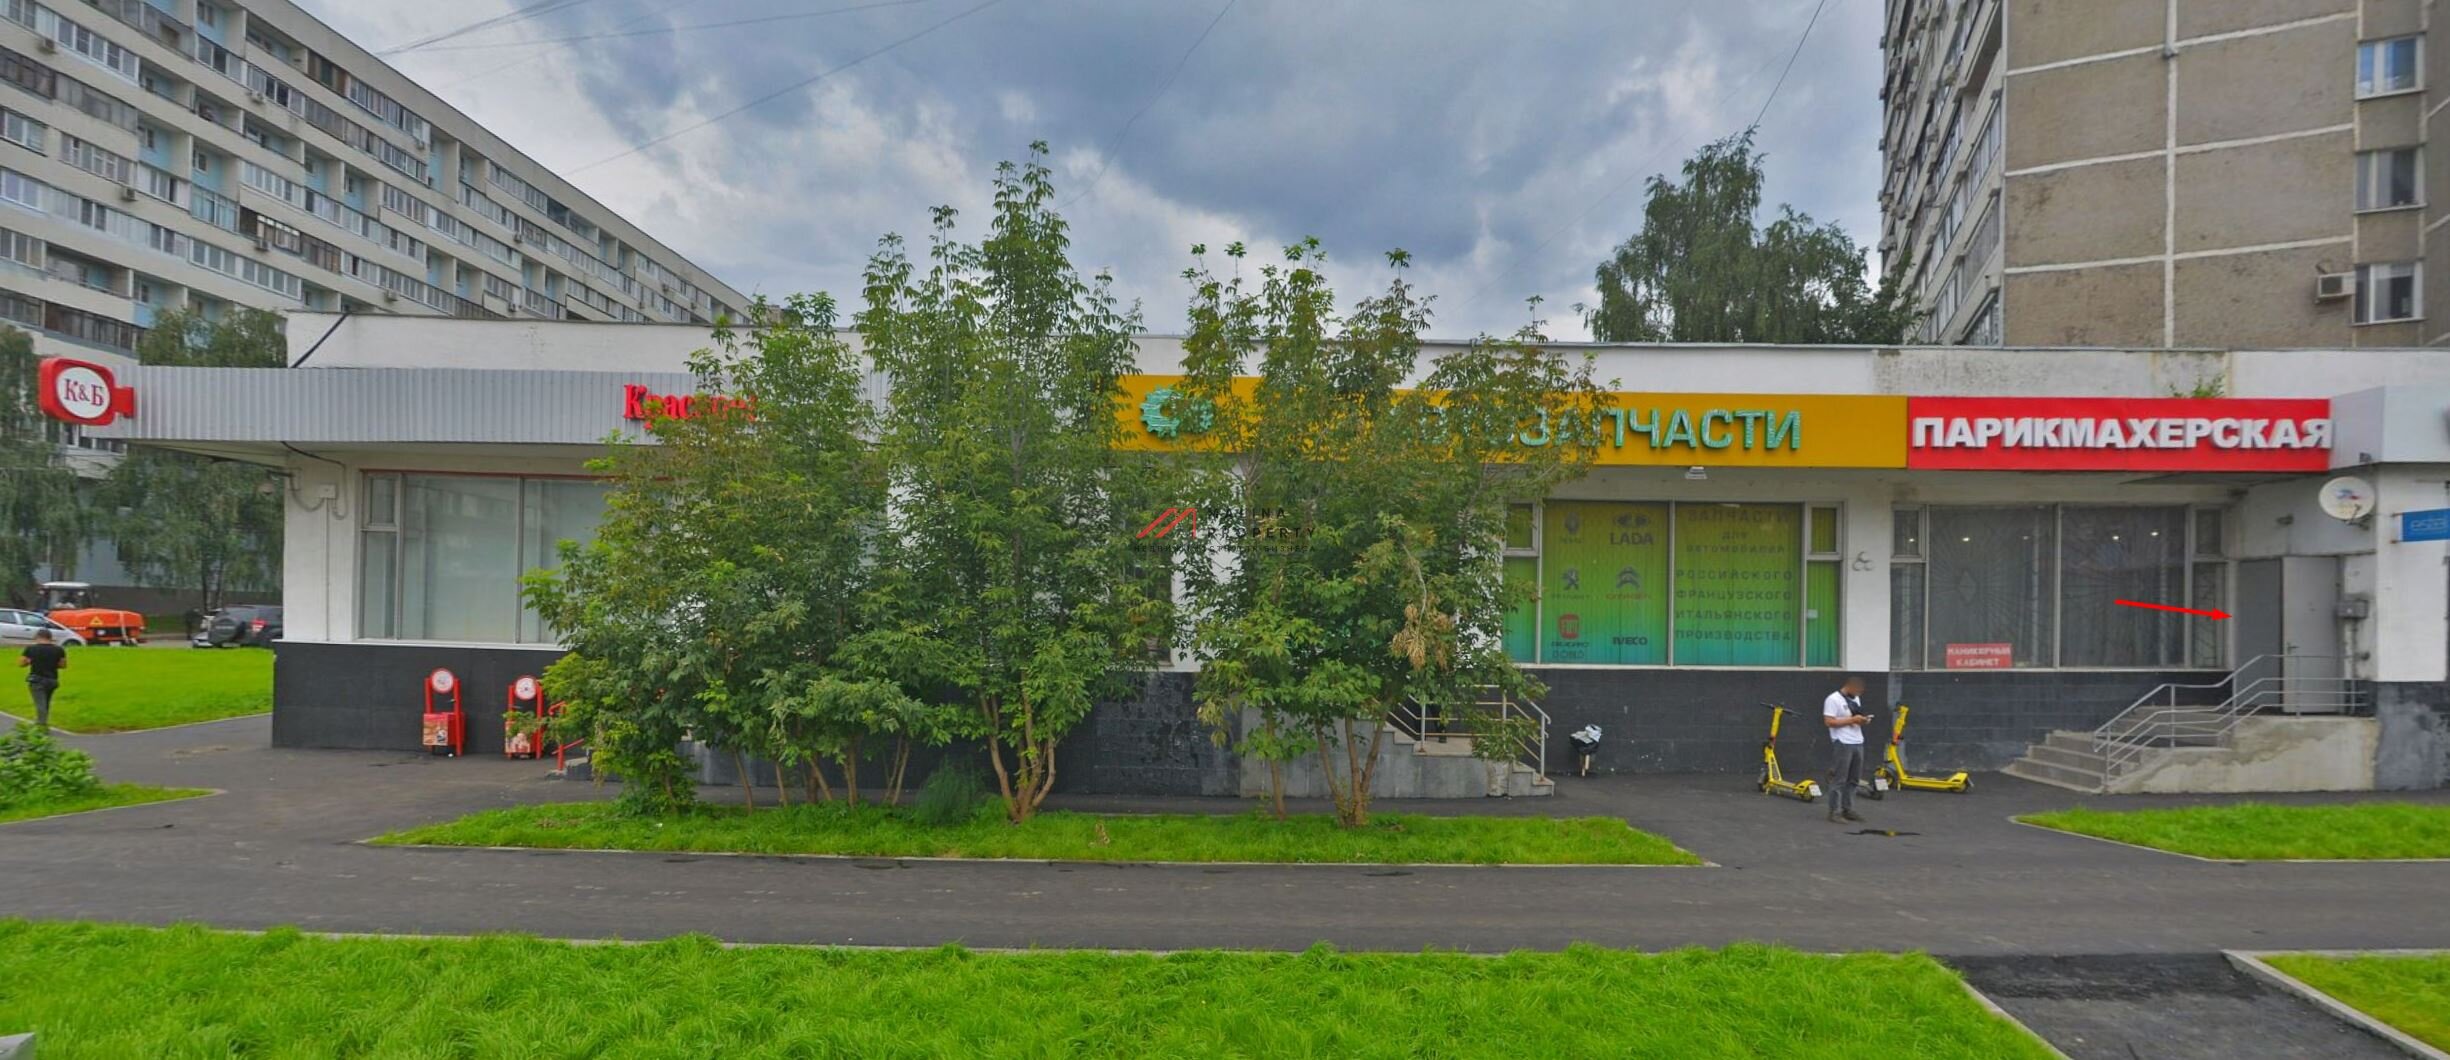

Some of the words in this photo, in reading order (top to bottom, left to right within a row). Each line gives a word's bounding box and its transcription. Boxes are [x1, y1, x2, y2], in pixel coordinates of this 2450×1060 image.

[63, 378, 104, 406] К&Б
[623, 384, 757, 430] Крас
[1384, 405, 1801, 449] ЗАПЧАСТИ
[1912, 417, 2332, 450] ПАРИКМАХЕРСКАЯ
[1687, 508, 1789, 523] ЗАПЧАСТИ
[1609, 532, 1654, 546] LADA
[1676, 569, 1793, 581] РОССИЙСКОГО
[1676, 590, 1793, 601] ФРАНЦУЗСКОГО
[1675, 609, 1792, 620] ИТАЛЬЯНСКОГО
[1612, 636, 1648, 645] IVECO
[1675, 630, 1792, 642] ПРОИЗВОДСТВА
